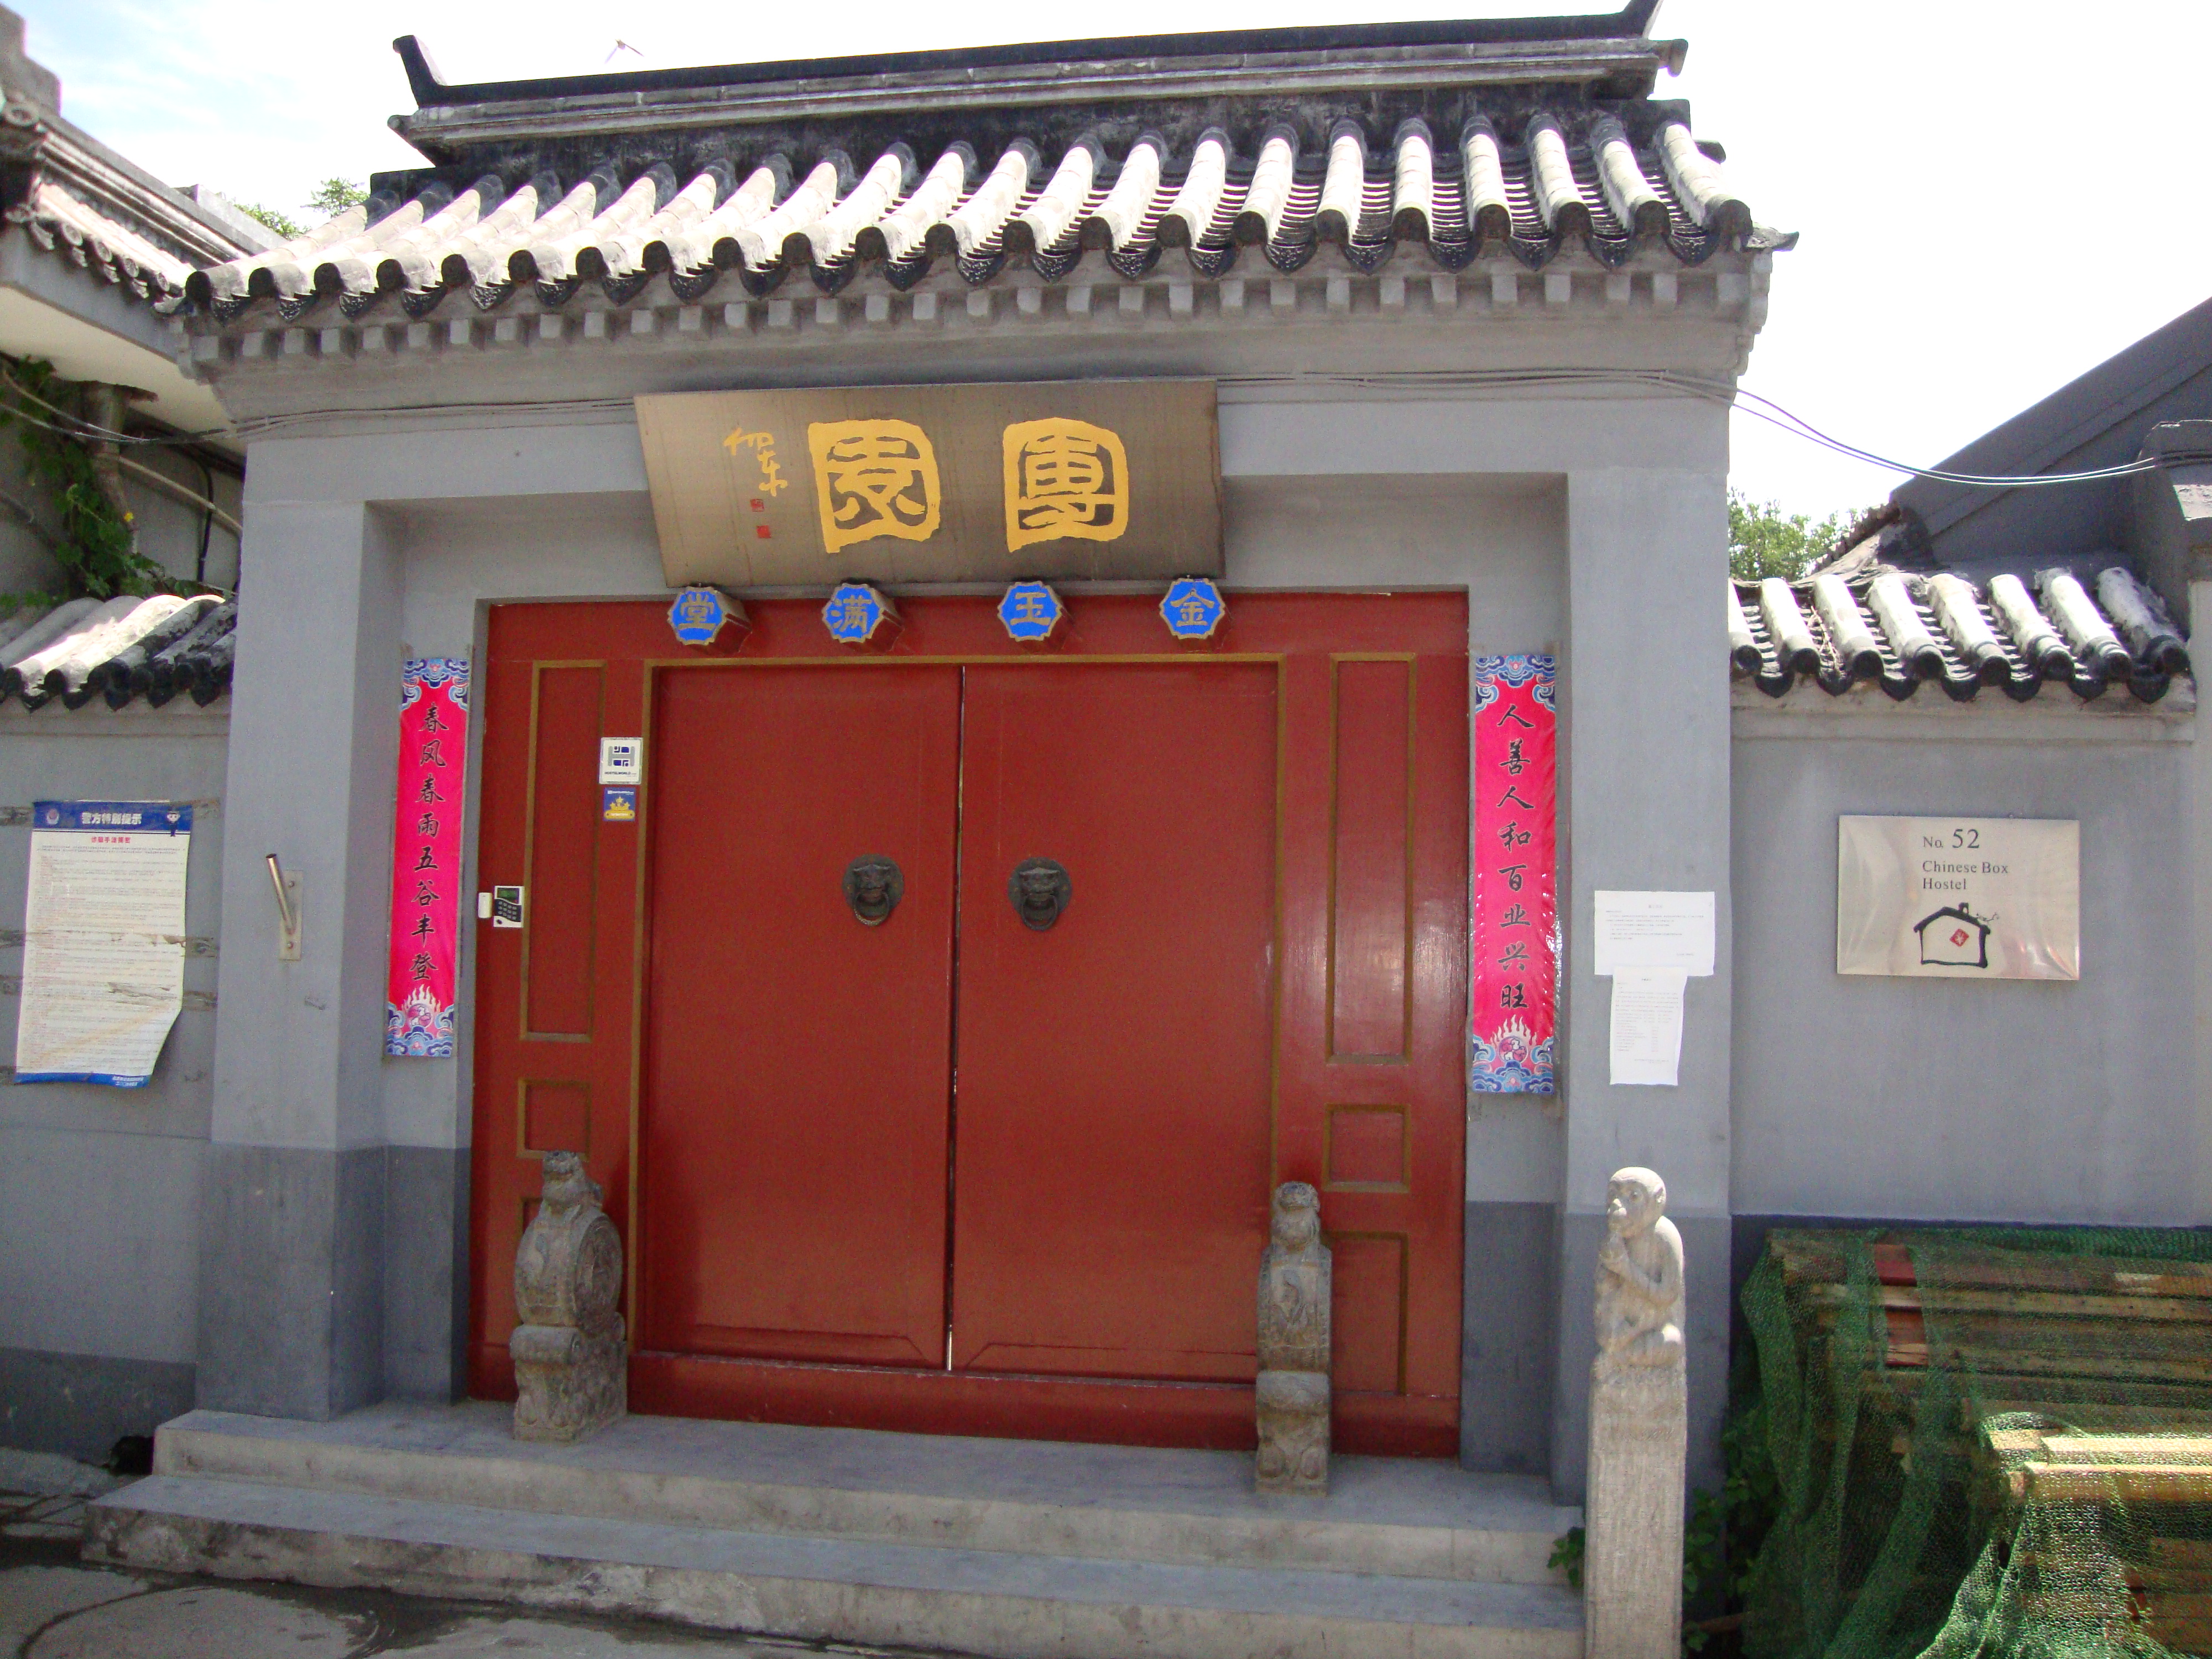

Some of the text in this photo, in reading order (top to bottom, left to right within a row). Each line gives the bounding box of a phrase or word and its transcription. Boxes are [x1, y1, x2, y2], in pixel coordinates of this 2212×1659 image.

[410, 703, 449, 980] 春风春雨五谷丰登
[1952, 829, 1980, 848] 52
[1497, 704, 1535, 1009] 人善人和百业兴旺
[1922, 860, 2008, 873] Chinese Box
[1923, 878, 1966, 890] Hostel
